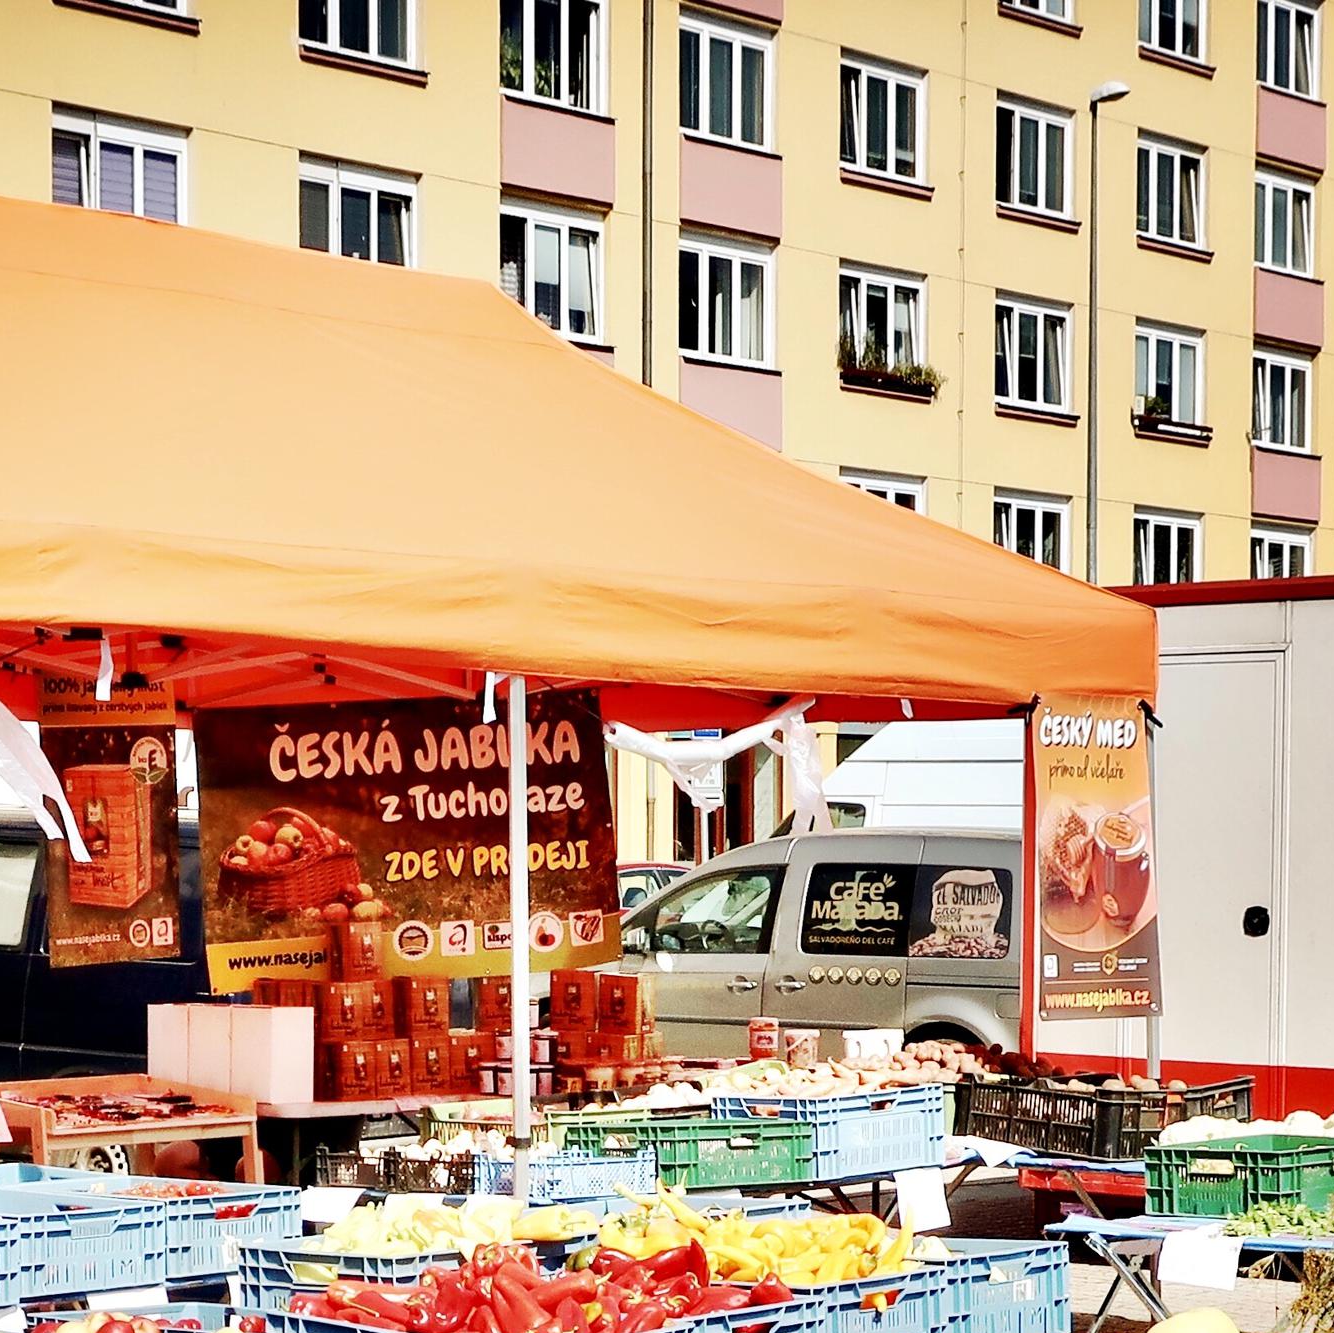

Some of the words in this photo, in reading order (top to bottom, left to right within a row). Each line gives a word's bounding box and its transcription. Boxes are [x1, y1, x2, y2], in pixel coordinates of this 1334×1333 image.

[1040, 706, 1094, 749] ČESKÝ
[1096, 718, 1137, 749] MED
[269, 719, 403, 782] ČESKÁ
[1049, 757, 1075, 789] přímo
[1090, 753, 1124, 783] včelaře
[380, 795, 403, 822] z
[408, 781, 585, 821] Tuchoaze
[385, 849, 439, 882] ZDE
[446, 848, 465, 877] V
[472, 840, 591, 877] PRDEJI
[1044, 988, 1150, 1012] www.nasejablka.cz
